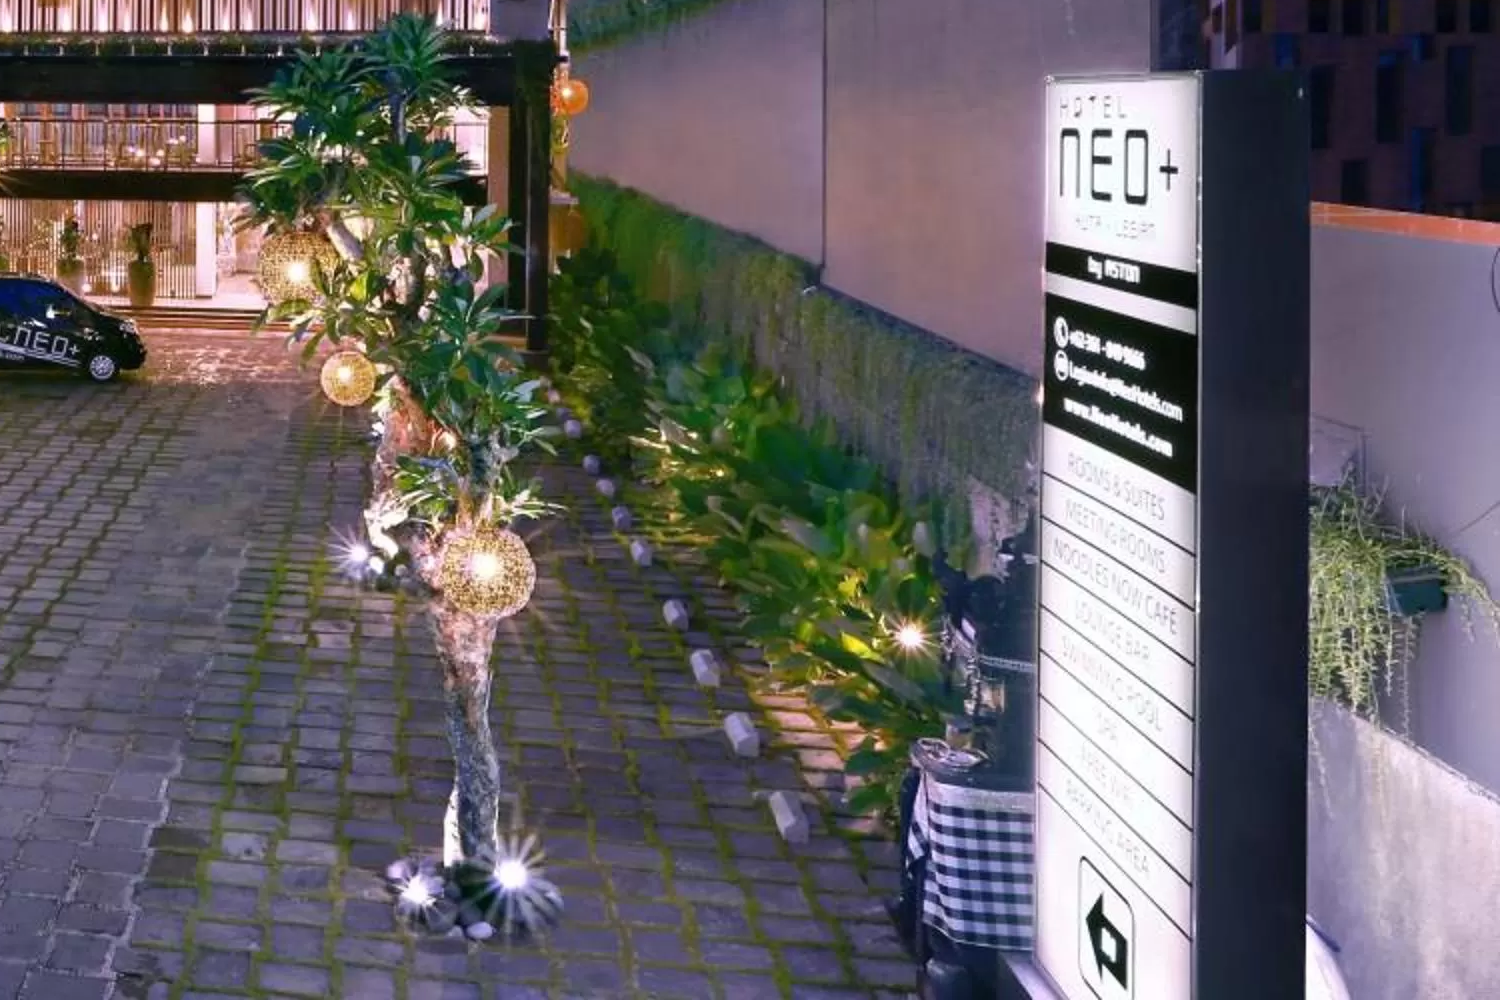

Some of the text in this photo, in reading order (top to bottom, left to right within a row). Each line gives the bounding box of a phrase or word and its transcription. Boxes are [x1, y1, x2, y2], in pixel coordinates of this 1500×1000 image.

[1060, 96, 1128, 119] HOTEL
[1068, 452, 1111, 492] ROOMS
[1123, 480, 1165, 521] SUITES
[1065, 499, 1166, 573] MEETING ROOMS
[1054, 538, 1109, 589] NOODLES
[1112, 572, 1142, 611] NOW
